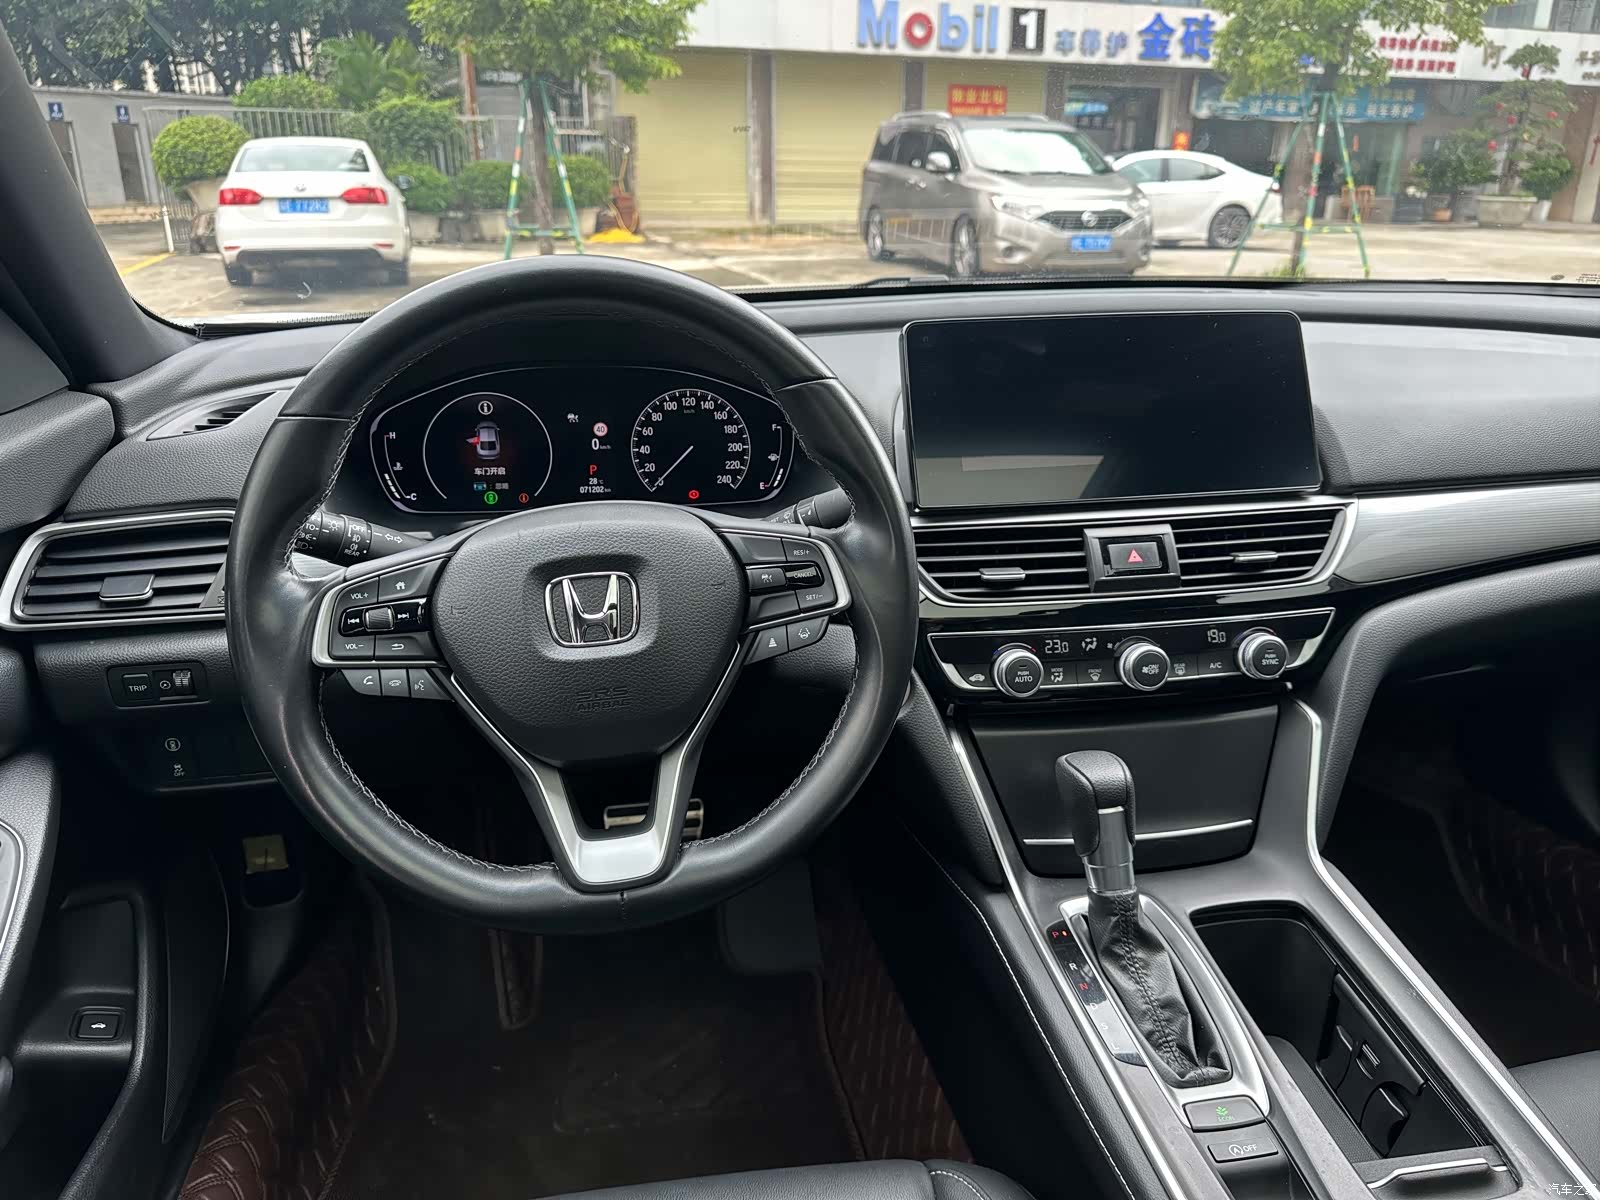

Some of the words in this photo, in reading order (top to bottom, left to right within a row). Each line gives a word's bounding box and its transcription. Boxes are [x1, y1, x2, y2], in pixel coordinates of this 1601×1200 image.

[857, 0, 999, 53] Mobil
[663, 402, 678, 411] 100
[681, 398, 696, 406] 120
[700, 401, 715, 410] 140
[651, 413, 663, 422] 80
[713, 411, 728, 420] 160
[642, 427, 653, 436] 60
[723, 425, 738, 434] 180
[591, 438, 600, 450] 0
[727, 443, 742, 451] 200
[639, 445, 650, 454] 40
[644, 463, 656, 472] 20
[725, 461, 740, 469] 220
[474, 467, 506, 476] 车门开启
[589, 465, 597, 475] P
[588, 477, 598, 485] 28
[717, 475, 732, 484] 240
[579, 486, 604, 494] 071202
[352, 524, 366, 533] OFF
[793, 571, 815, 579] CANCEL
[1207, 629, 1227, 643] 19.0
[1044, 639, 1070, 654] 23.0
[1209, 661, 1223, 669] A/C
[1261, 658, 1280, 666] SYNC
[1014, 675, 1033, 683] AUTO
[128, 684, 148, 692] TRIP
[1051, 931, 1060, 939] P
[1068, 962, 1078, 971] R
[1078, 982, 1089, 991] N
[1243, 1143, 1258, 1152] OFF
